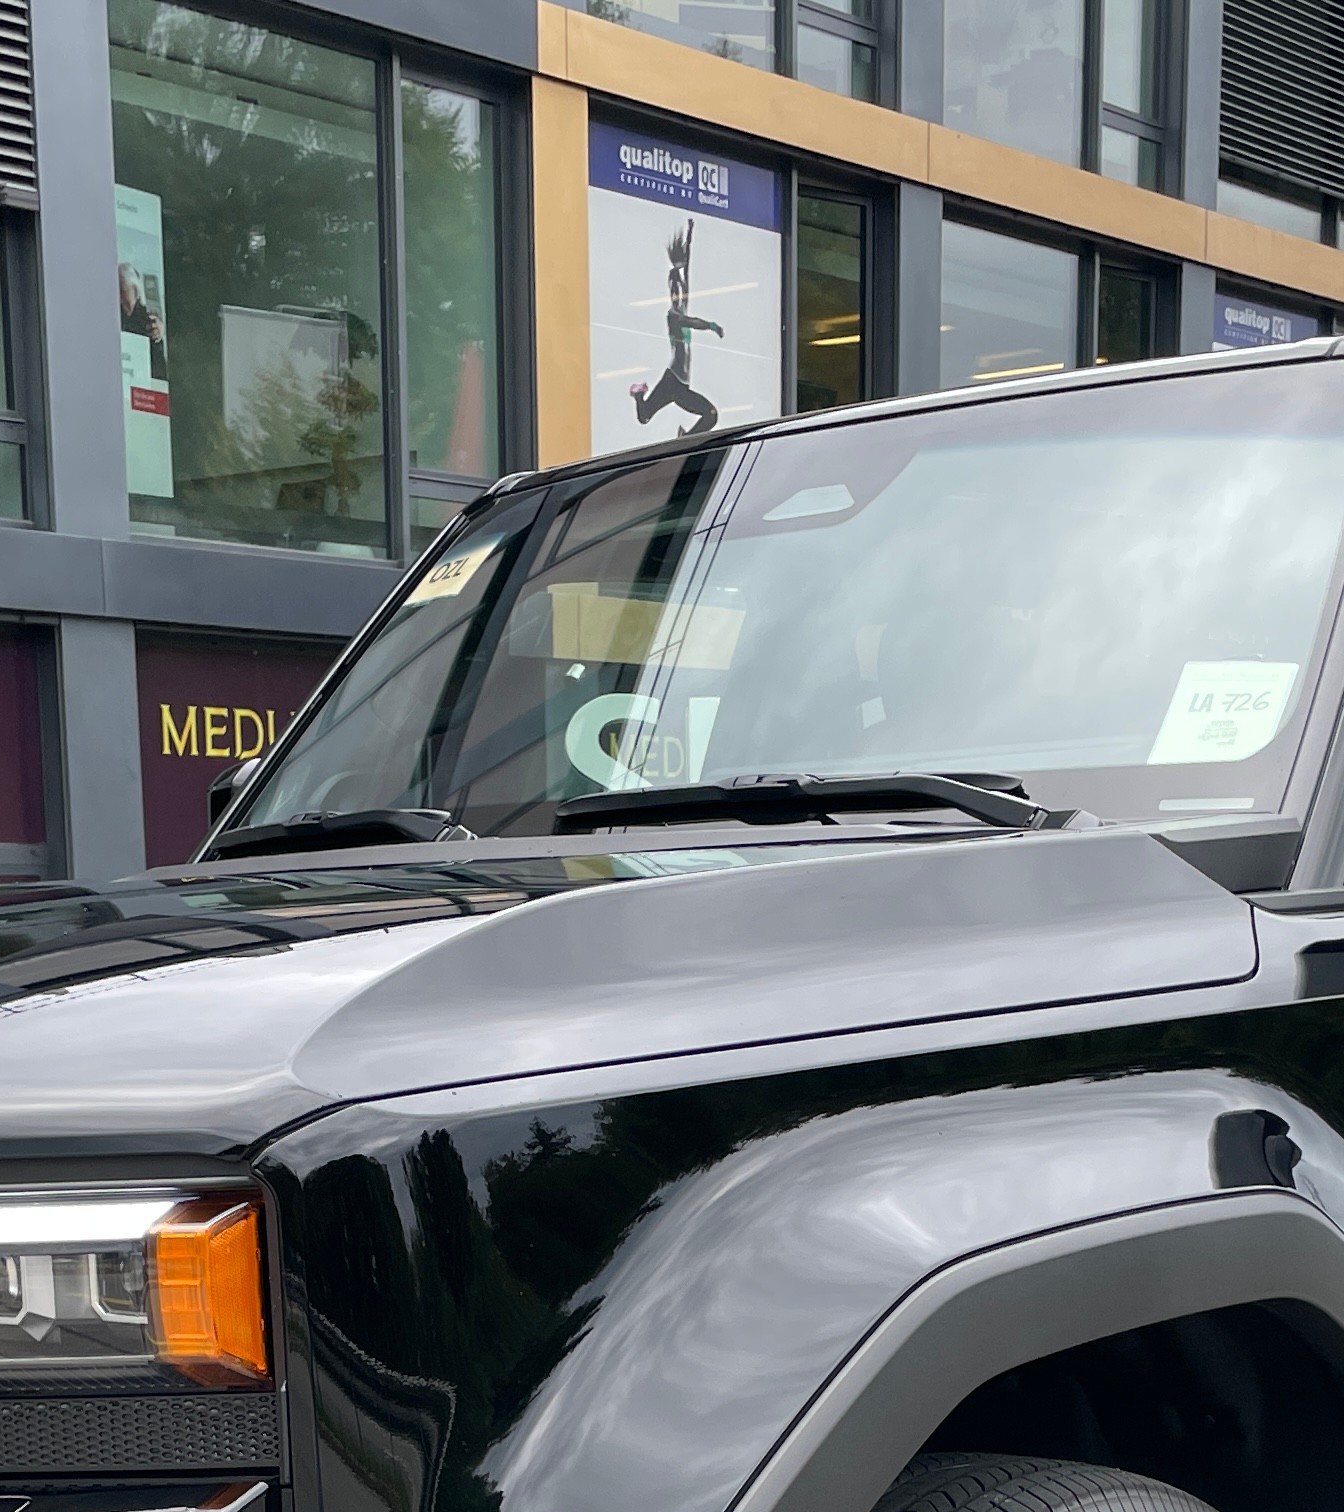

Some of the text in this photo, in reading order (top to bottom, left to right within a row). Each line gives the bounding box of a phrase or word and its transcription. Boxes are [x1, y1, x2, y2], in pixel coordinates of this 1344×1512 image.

[620, 144, 694, 183] qualitop
[1224, 307, 1271, 334] qualitop
[1187, 691, 1272, 713] LA 726
